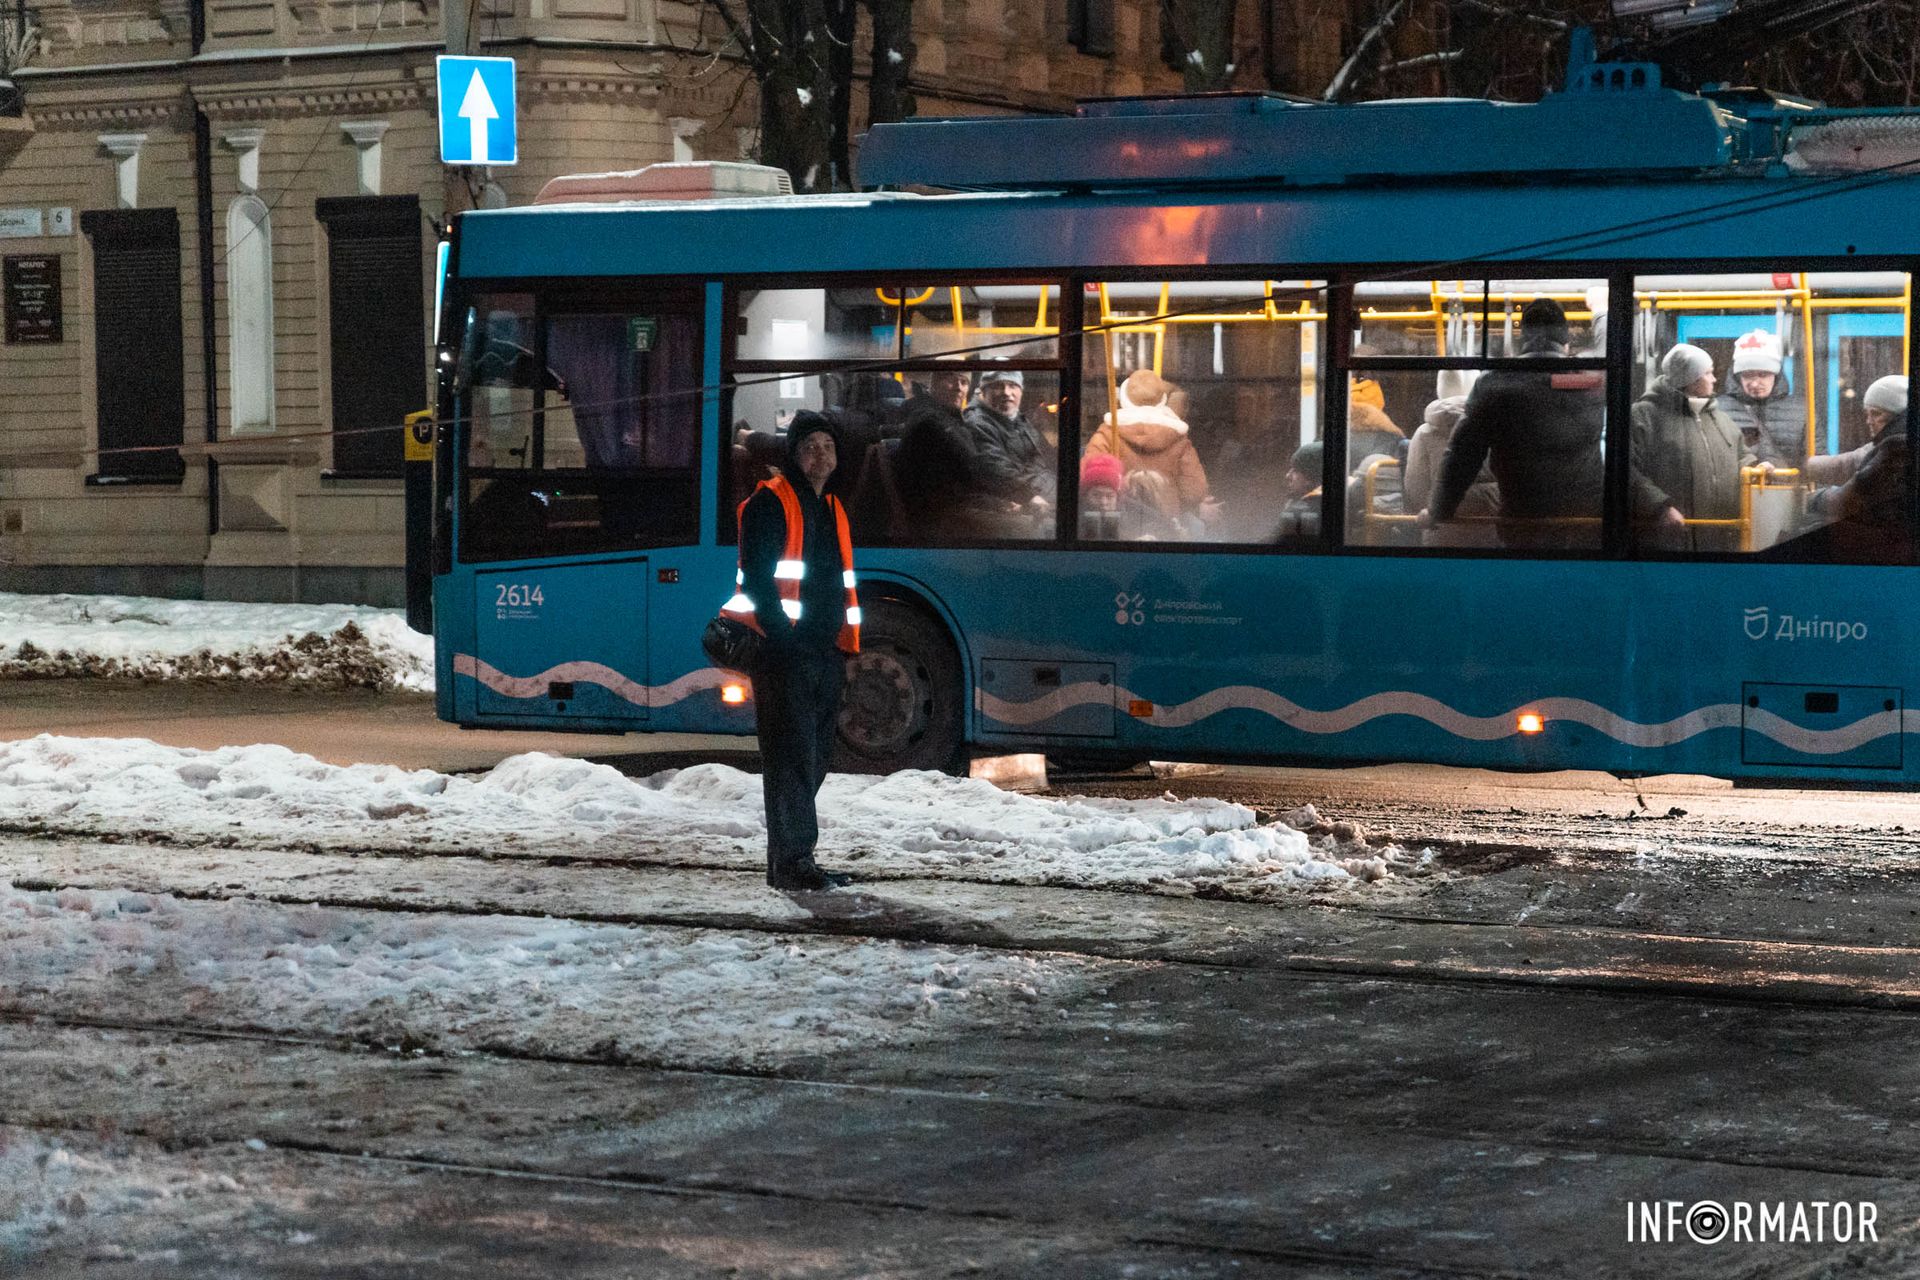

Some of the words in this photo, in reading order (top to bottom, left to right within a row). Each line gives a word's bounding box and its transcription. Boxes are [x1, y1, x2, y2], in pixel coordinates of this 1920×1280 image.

[55, 211, 63, 223] 6
[496, 584, 544, 606] 2614
[1775, 614, 1868, 643] Дніпро
